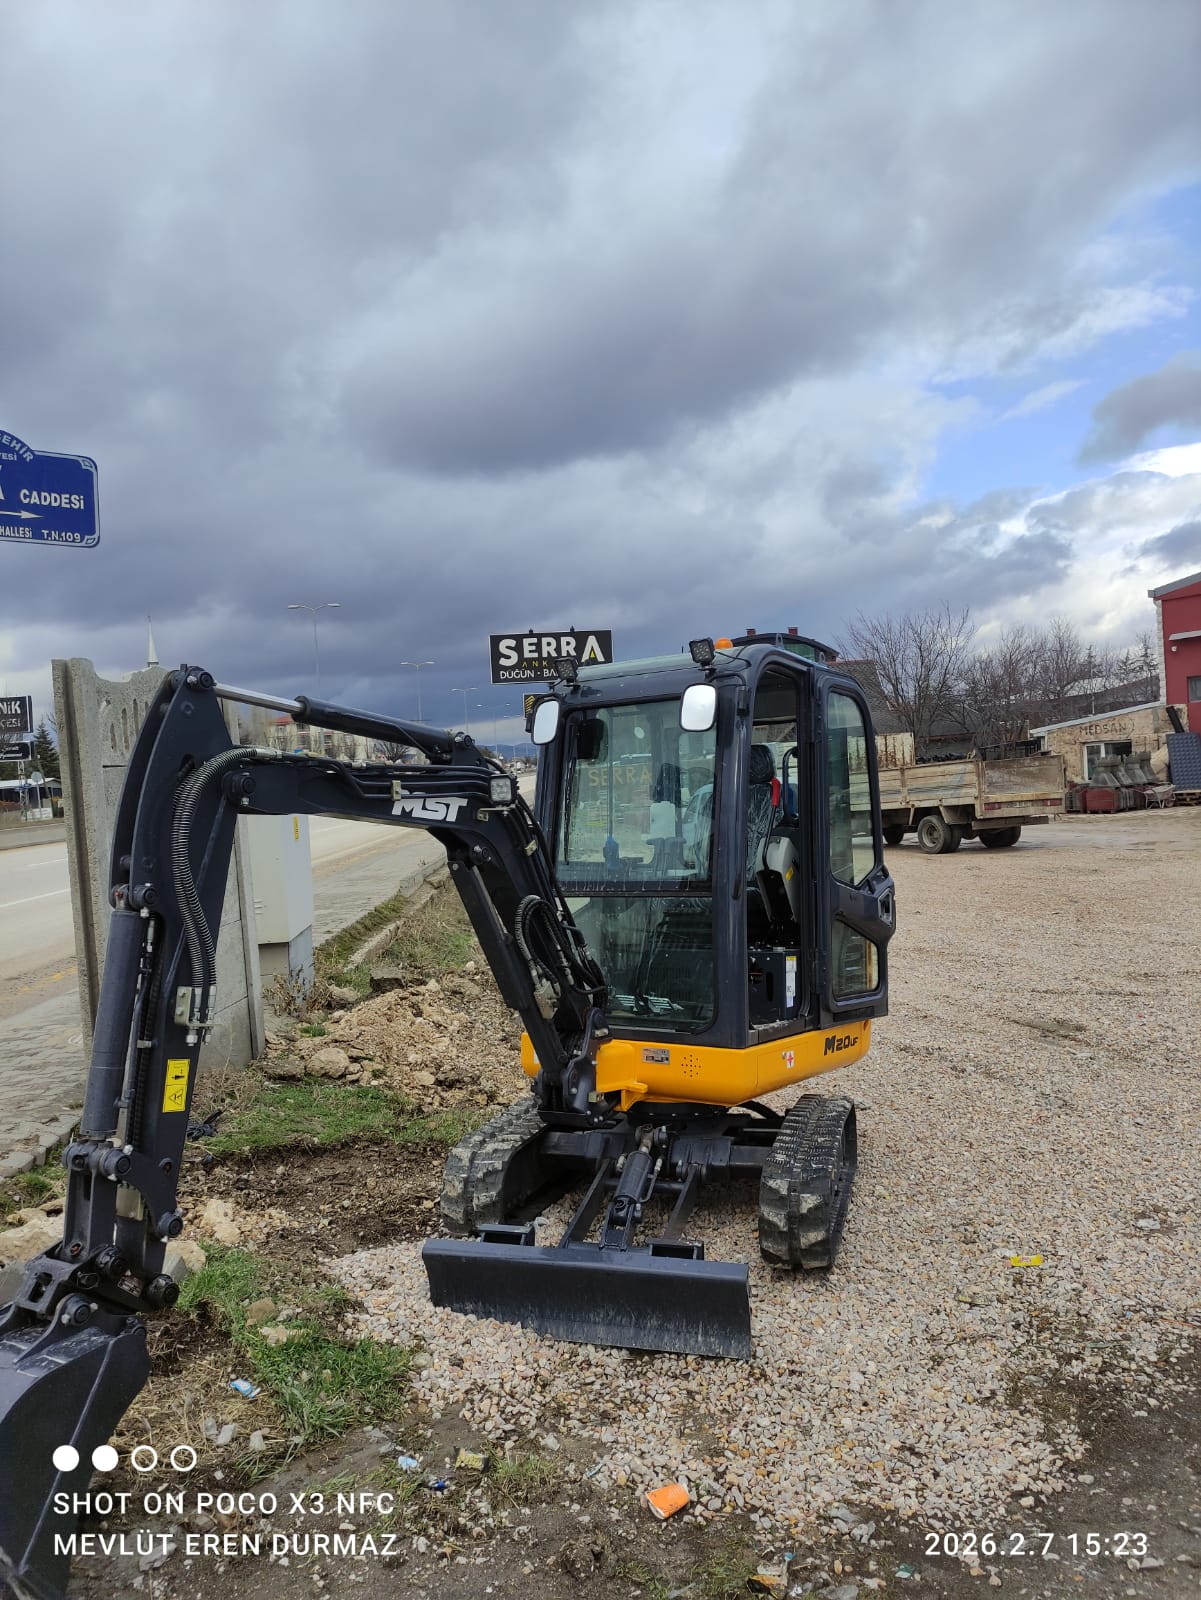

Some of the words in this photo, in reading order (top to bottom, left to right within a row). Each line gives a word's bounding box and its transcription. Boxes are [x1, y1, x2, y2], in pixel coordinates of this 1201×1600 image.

[41, 529, 81, 543] T.N.109
[498, 635, 605, 667] SERRA
[499, 668, 535, 680] DÜĞÜN
[1079, 722, 1127, 736] MEDSAN
[391, 797, 468, 822] MST
